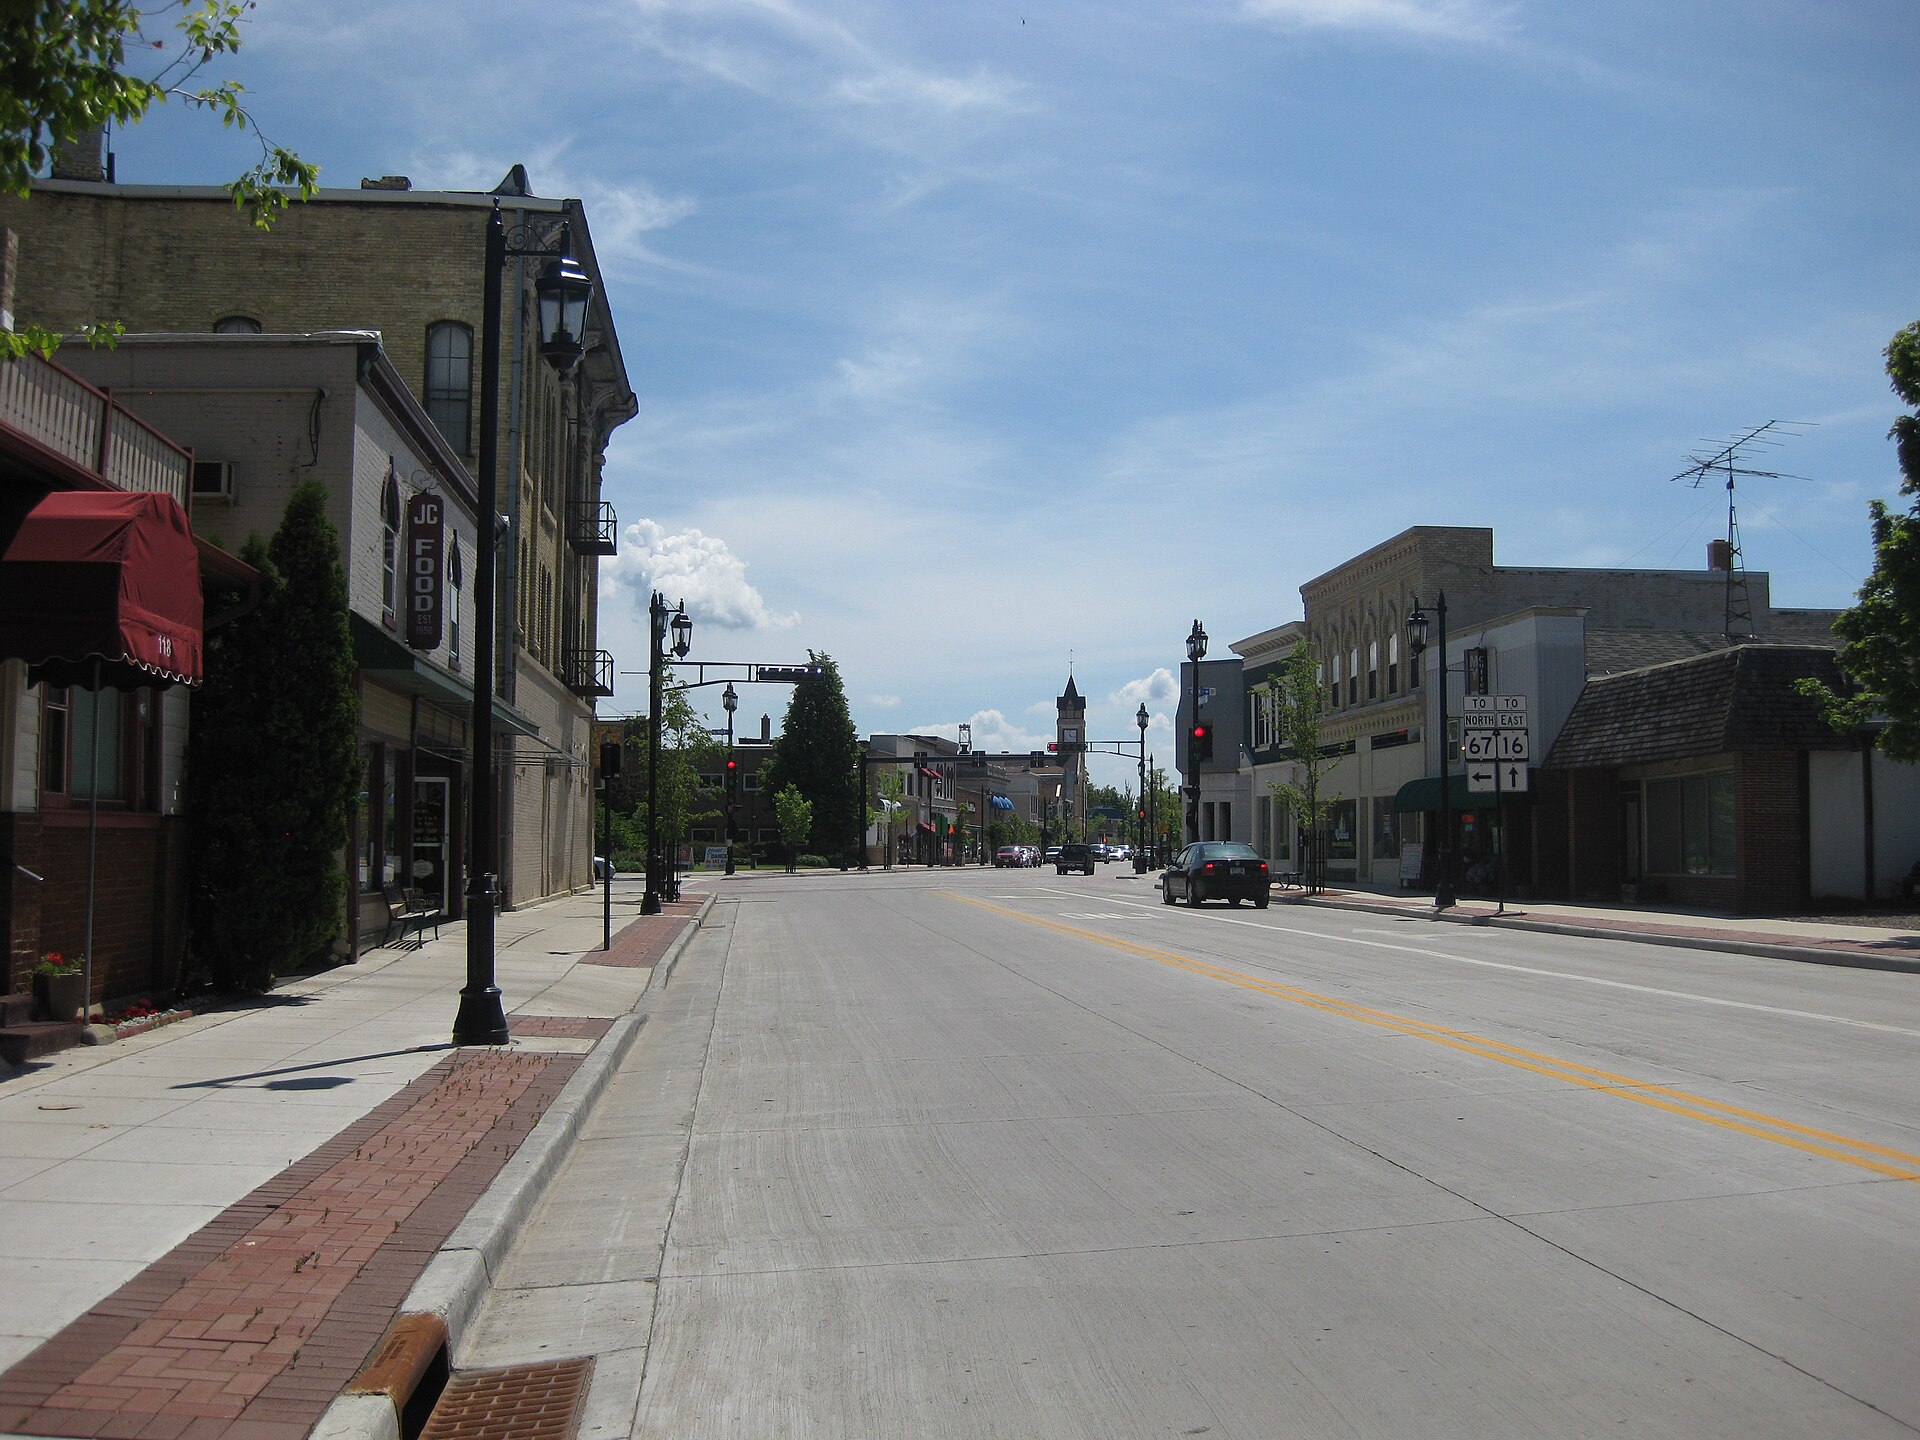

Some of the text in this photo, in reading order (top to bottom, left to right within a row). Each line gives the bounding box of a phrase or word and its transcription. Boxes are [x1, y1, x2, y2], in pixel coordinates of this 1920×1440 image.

[414, 504, 438, 525] JC
[415, 539, 435, 612] FOOD
[417, 614, 432, 624] EST
[158, 635, 172, 657] 118
[1472, 699, 1486, 708] TO
[1504, 699, 1518, 708] TO
[1465, 715, 1494, 725] NORTH
[1501, 715, 1524, 725] EAST
[1469, 737, 1492, 754] 67
[1503, 737, 1523, 754] 16
